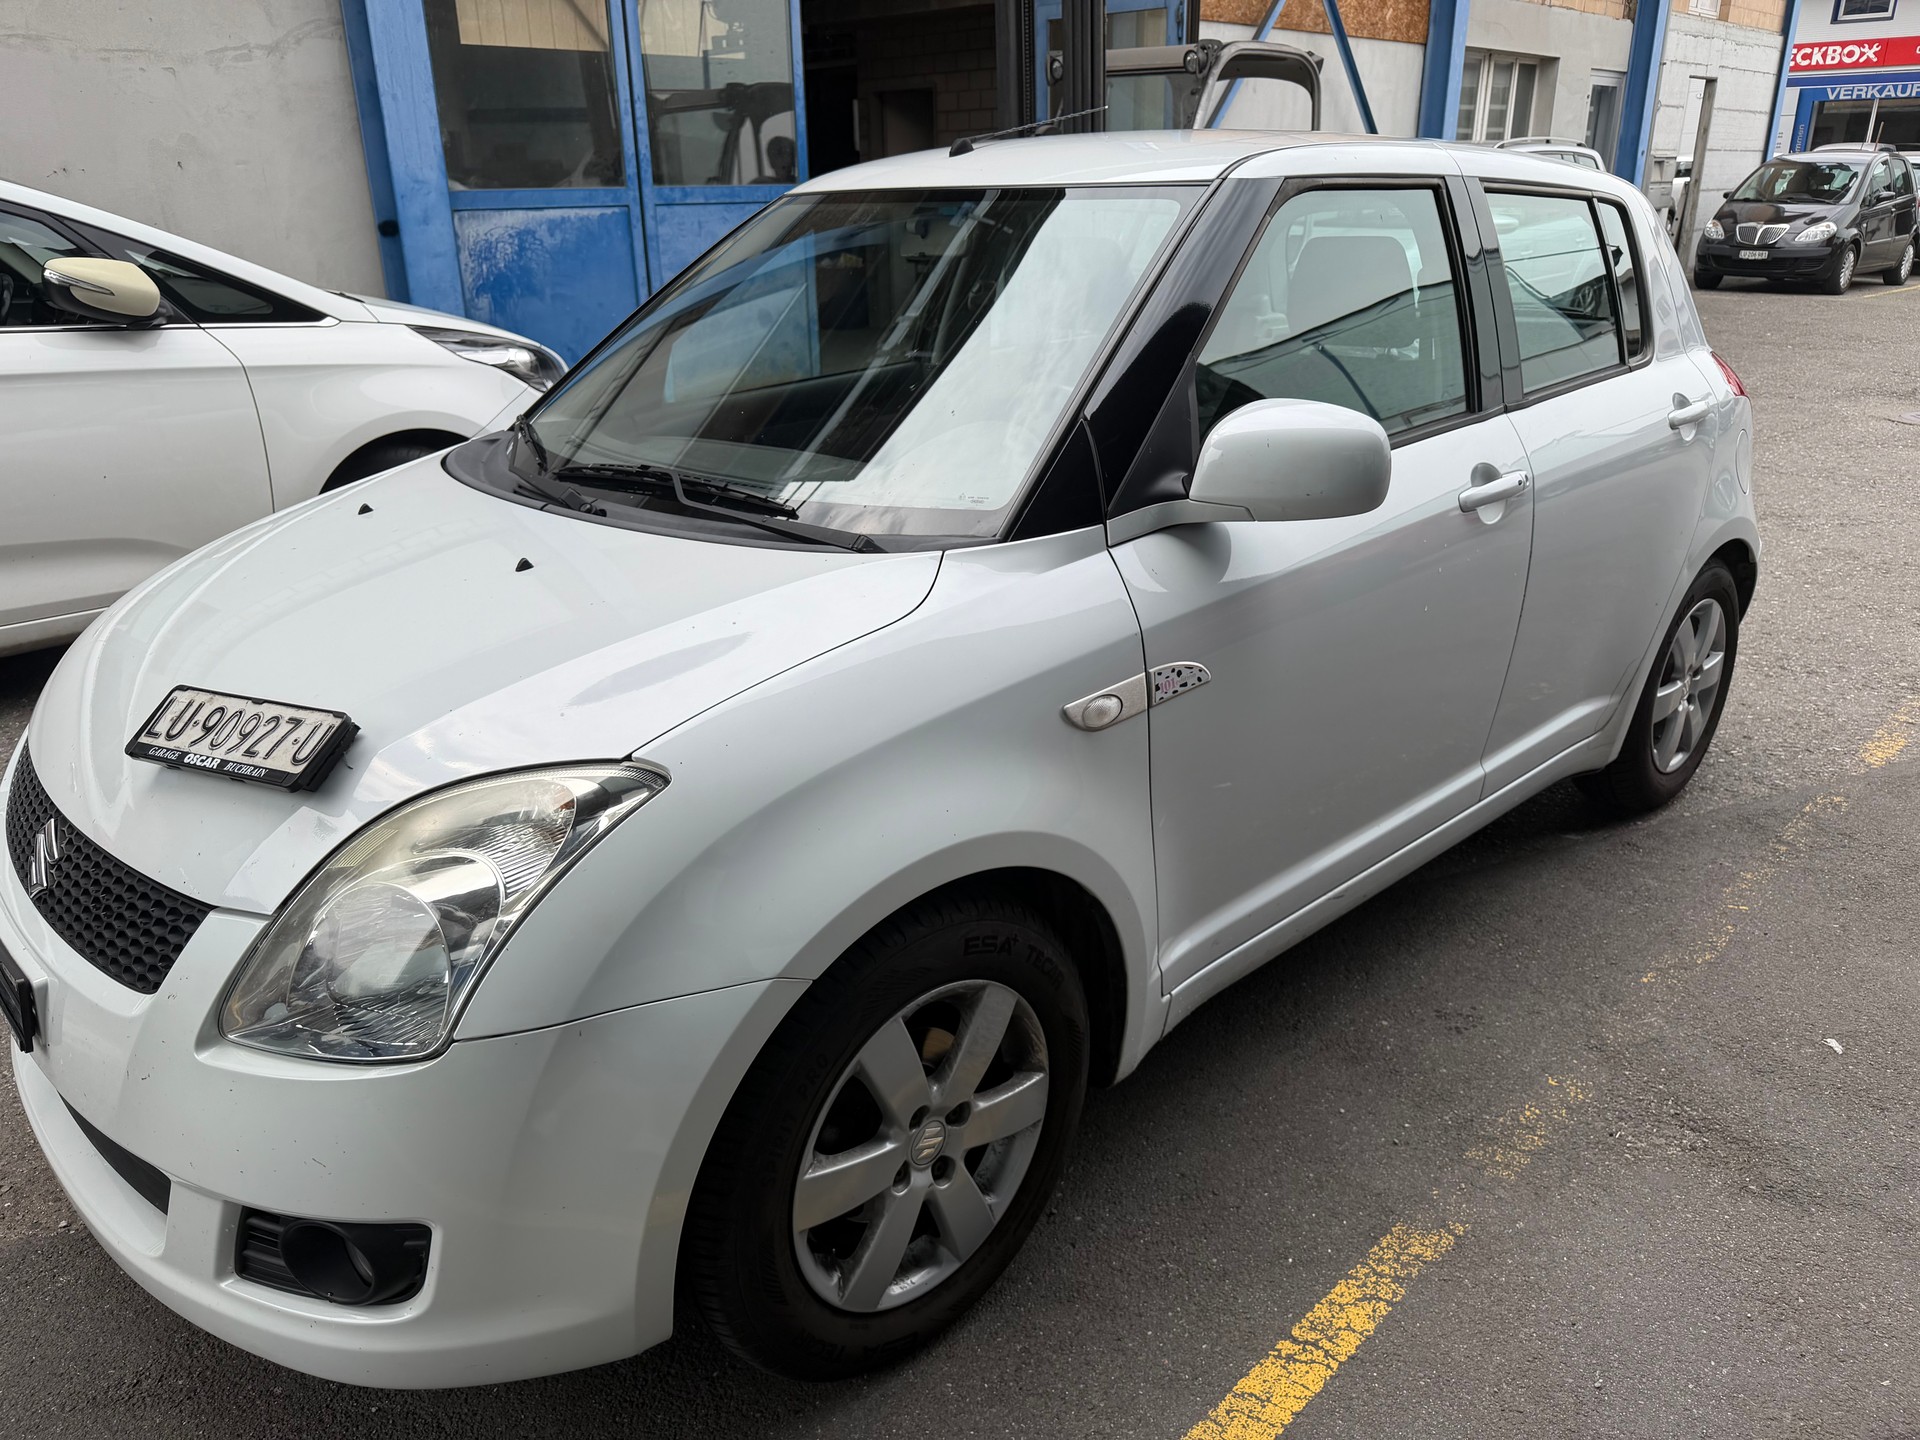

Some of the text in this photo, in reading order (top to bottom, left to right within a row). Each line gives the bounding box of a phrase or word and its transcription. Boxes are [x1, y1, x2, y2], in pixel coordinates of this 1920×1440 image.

[148, 746, 268, 778] GARAGE OSCAR BUCHRAIN
